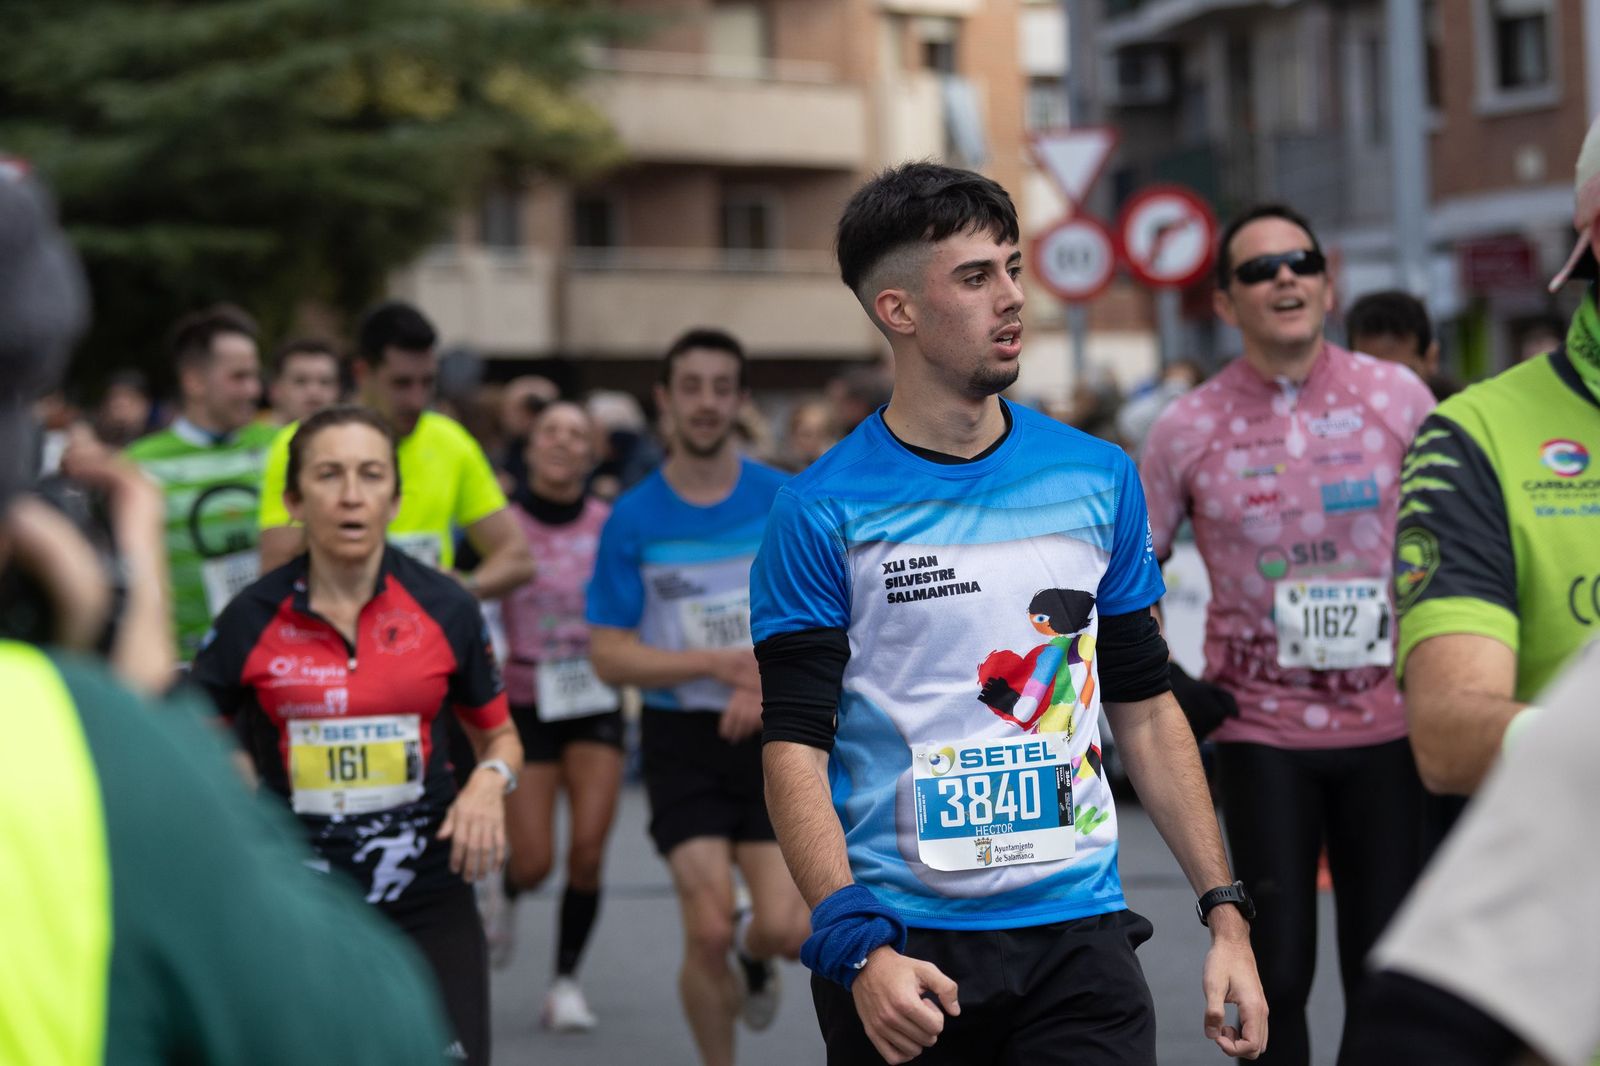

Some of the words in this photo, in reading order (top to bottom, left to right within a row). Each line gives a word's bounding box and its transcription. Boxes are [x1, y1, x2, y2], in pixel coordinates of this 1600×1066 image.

[1291, 540, 1338, 565] SIS
[882, 560, 906, 575] XLI
[908, 555, 939, 570] SAN
[885, 568, 956, 590] SILVESTRE
[887, 581, 982, 604] SALMANTINA
[1303, 604, 1358, 639] 1162
[323, 723, 405, 742] SETEL
[328, 745, 368, 785] 161
[958, 741, 1057, 769] SETEL
[938, 769, 1042, 828] 3840
[975, 822, 1014, 836] HECTOR
[994, 842, 1034, 854] Ayuntamiento
[994, 854, 1003, 863] de
[1004, 851, 1035, 863] Salamanca
